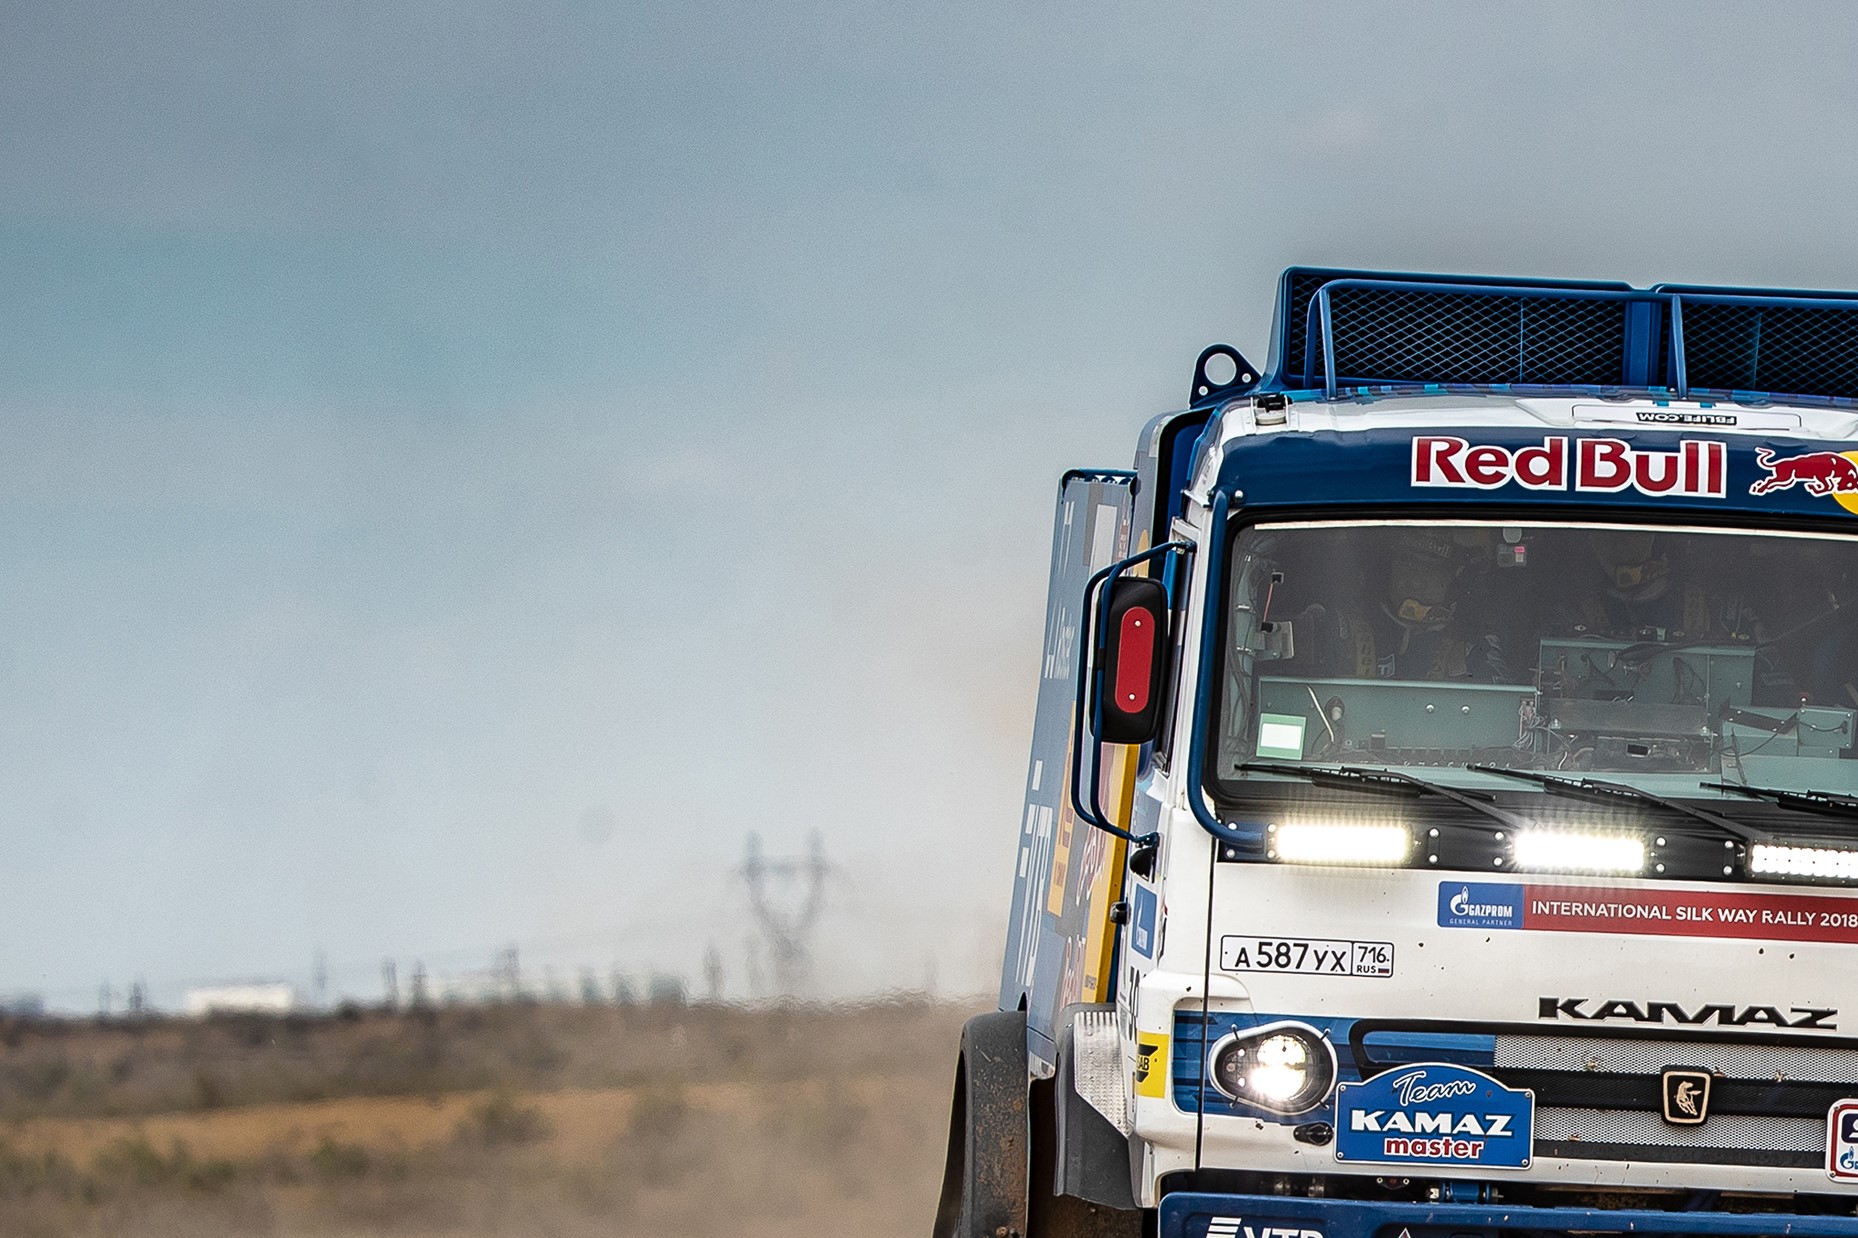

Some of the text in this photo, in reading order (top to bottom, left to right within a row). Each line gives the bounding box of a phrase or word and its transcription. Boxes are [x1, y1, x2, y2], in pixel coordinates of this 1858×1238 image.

[1638, 413, 1736, 425] FBLIFE.COM
[1413, 437, 1724, 495] Red Bull
[1468, 904, 1513, 917] GAZPROM
[1532, 900, 1858, 928] INTERNATIONAL SILK WAY RALLY 2018
[1357, 946, 1386, 963] 716
[1356, 964, 1377, 973] RUS
[1538, 997, 1838, 1031] KAMAZ
[1393, 1071, 1476, 1106] Team
[1351, 1109, 1513, 1137] KAMAZ
[1385, 1137, 1485, 1159] master
